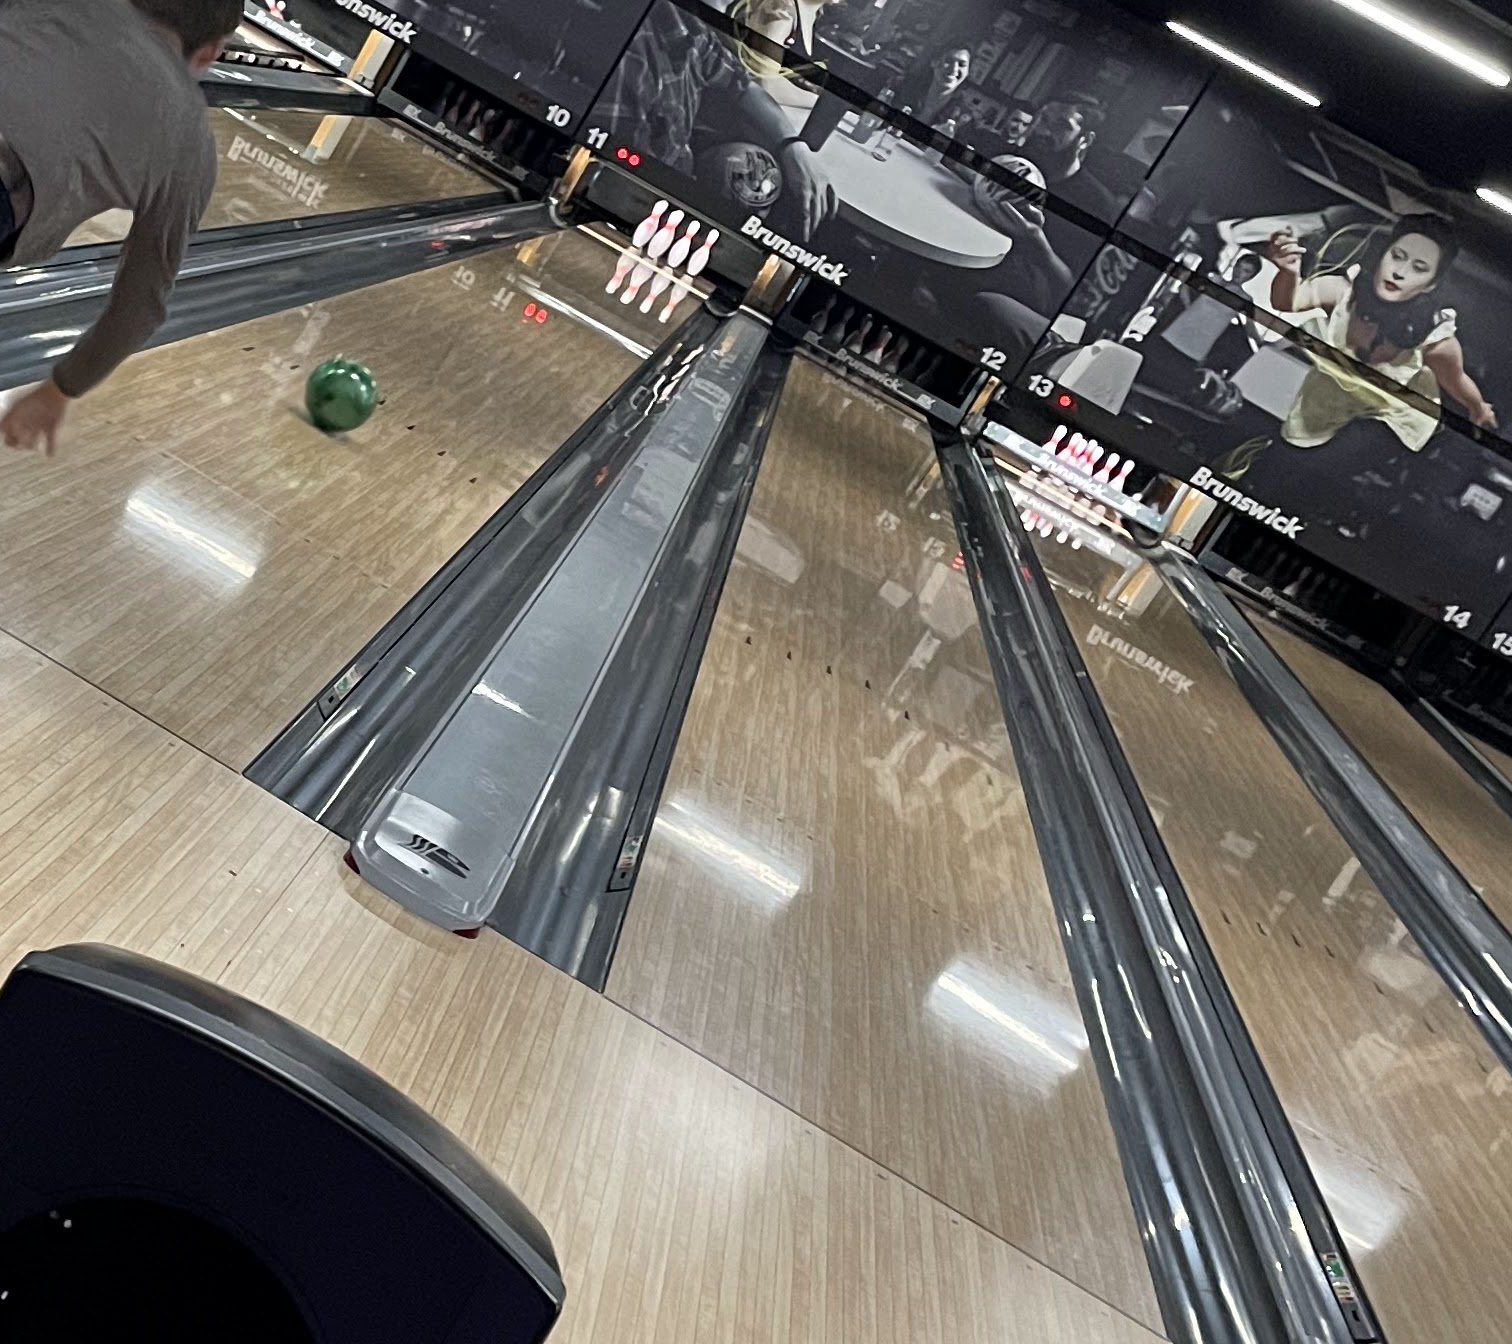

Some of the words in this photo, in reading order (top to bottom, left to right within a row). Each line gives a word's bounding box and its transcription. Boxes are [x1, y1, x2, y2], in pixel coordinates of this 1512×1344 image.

[254, 9, 316, 51] Brunswick
[546, 104, 571, 127] 10
[587, 127, 609, 150] 11
[741, 214, 849, 287] Brunswick
[980, 347, 1007, 371] 12
[1028, 374, 1055, 398] 13
[1189, 465, 1306, 541] Brunswick
[1443, 605, 1472, 629] 14
